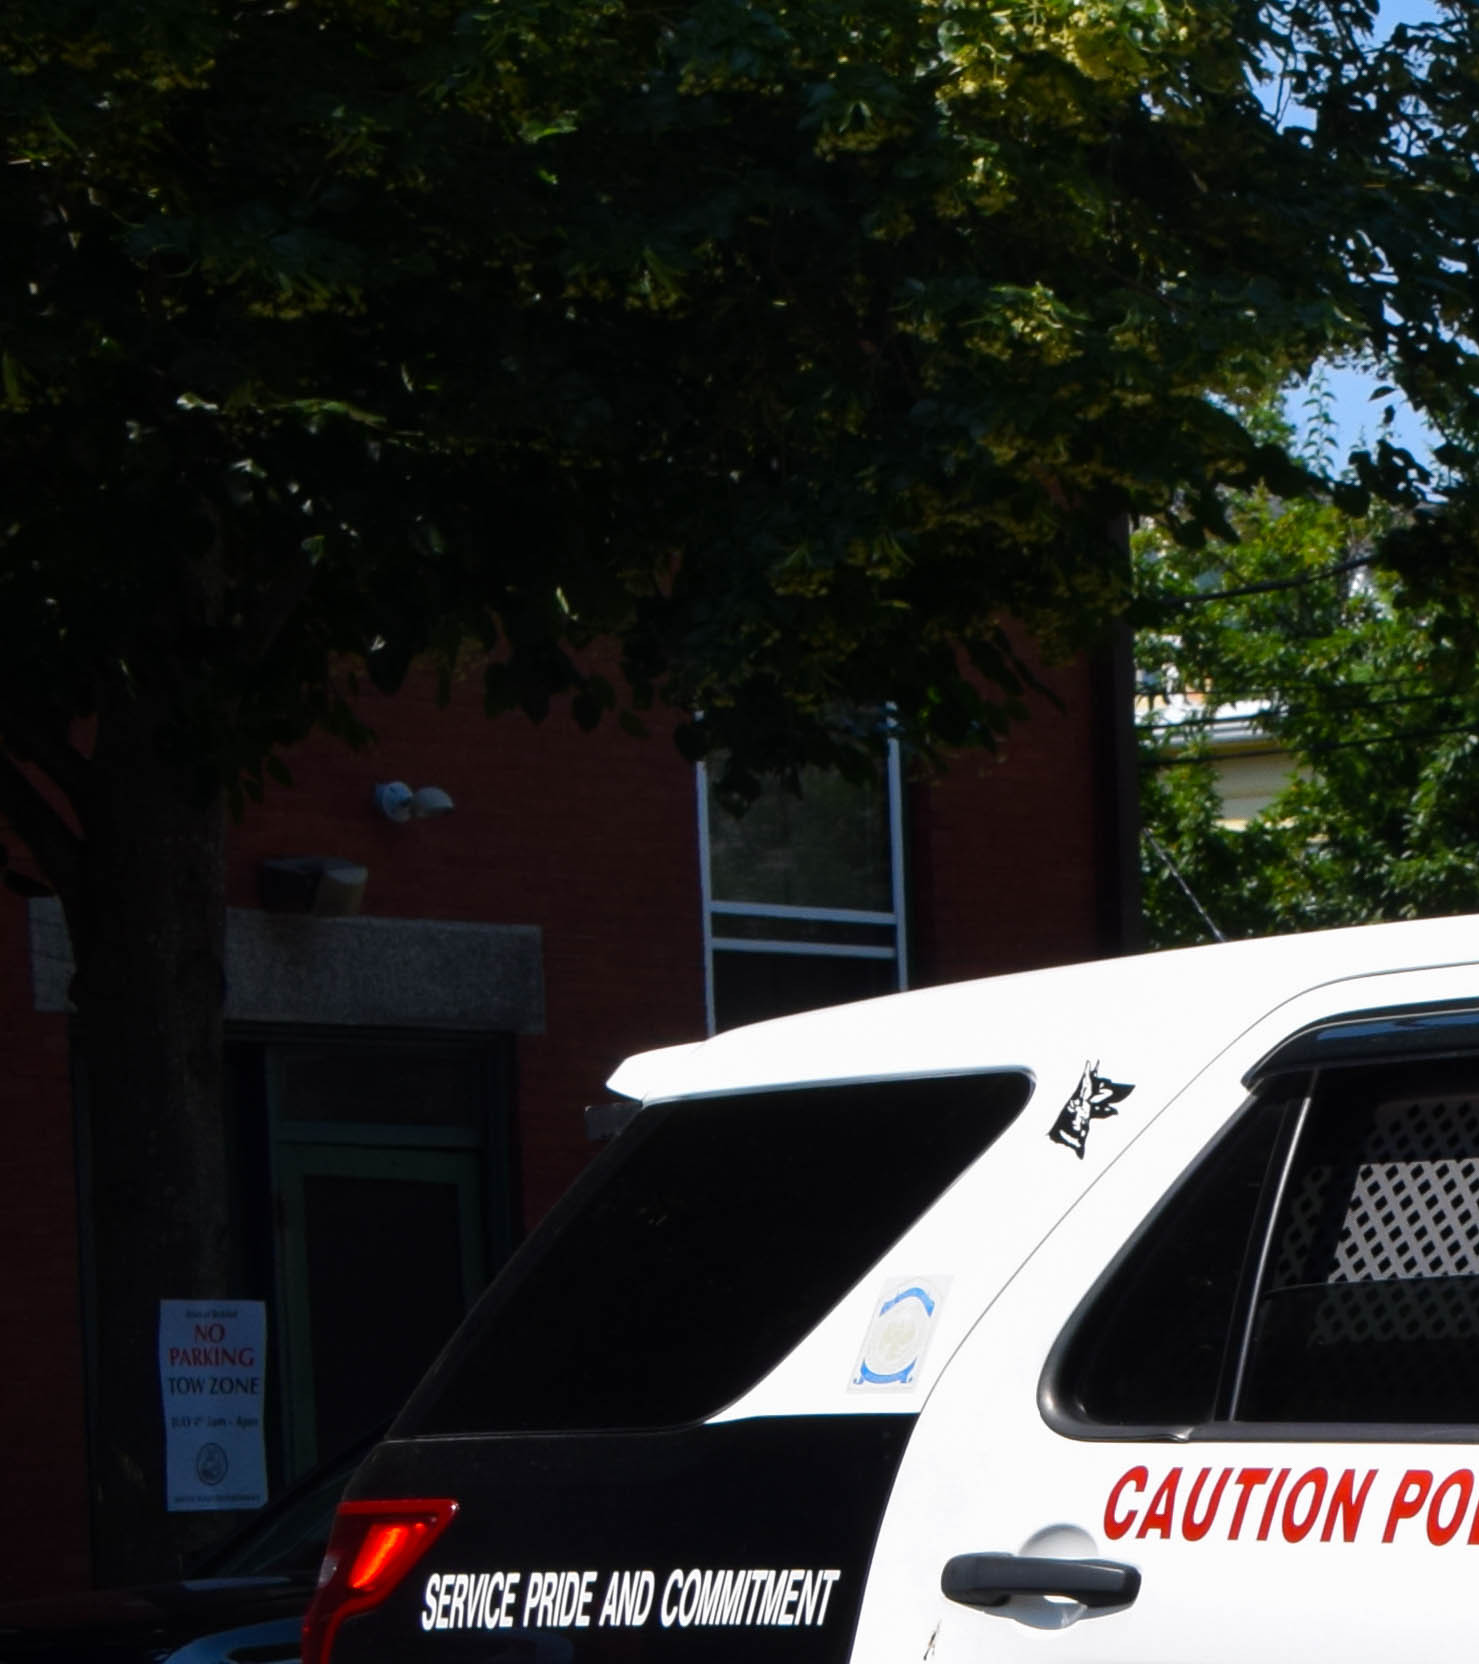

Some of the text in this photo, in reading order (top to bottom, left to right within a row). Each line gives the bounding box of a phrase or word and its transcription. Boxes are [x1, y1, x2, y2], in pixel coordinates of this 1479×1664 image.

[195, 1323, 225, 1344] NO
[168, 1347, 256, 1368] PARKING
[168, 1376, 260, 1396] TOW ZONE
[1105, 1467, 1376, 1542] CAUTION
[421, 1569, 841, 1630] SERVICE PRIDE AND COMMITMENT
